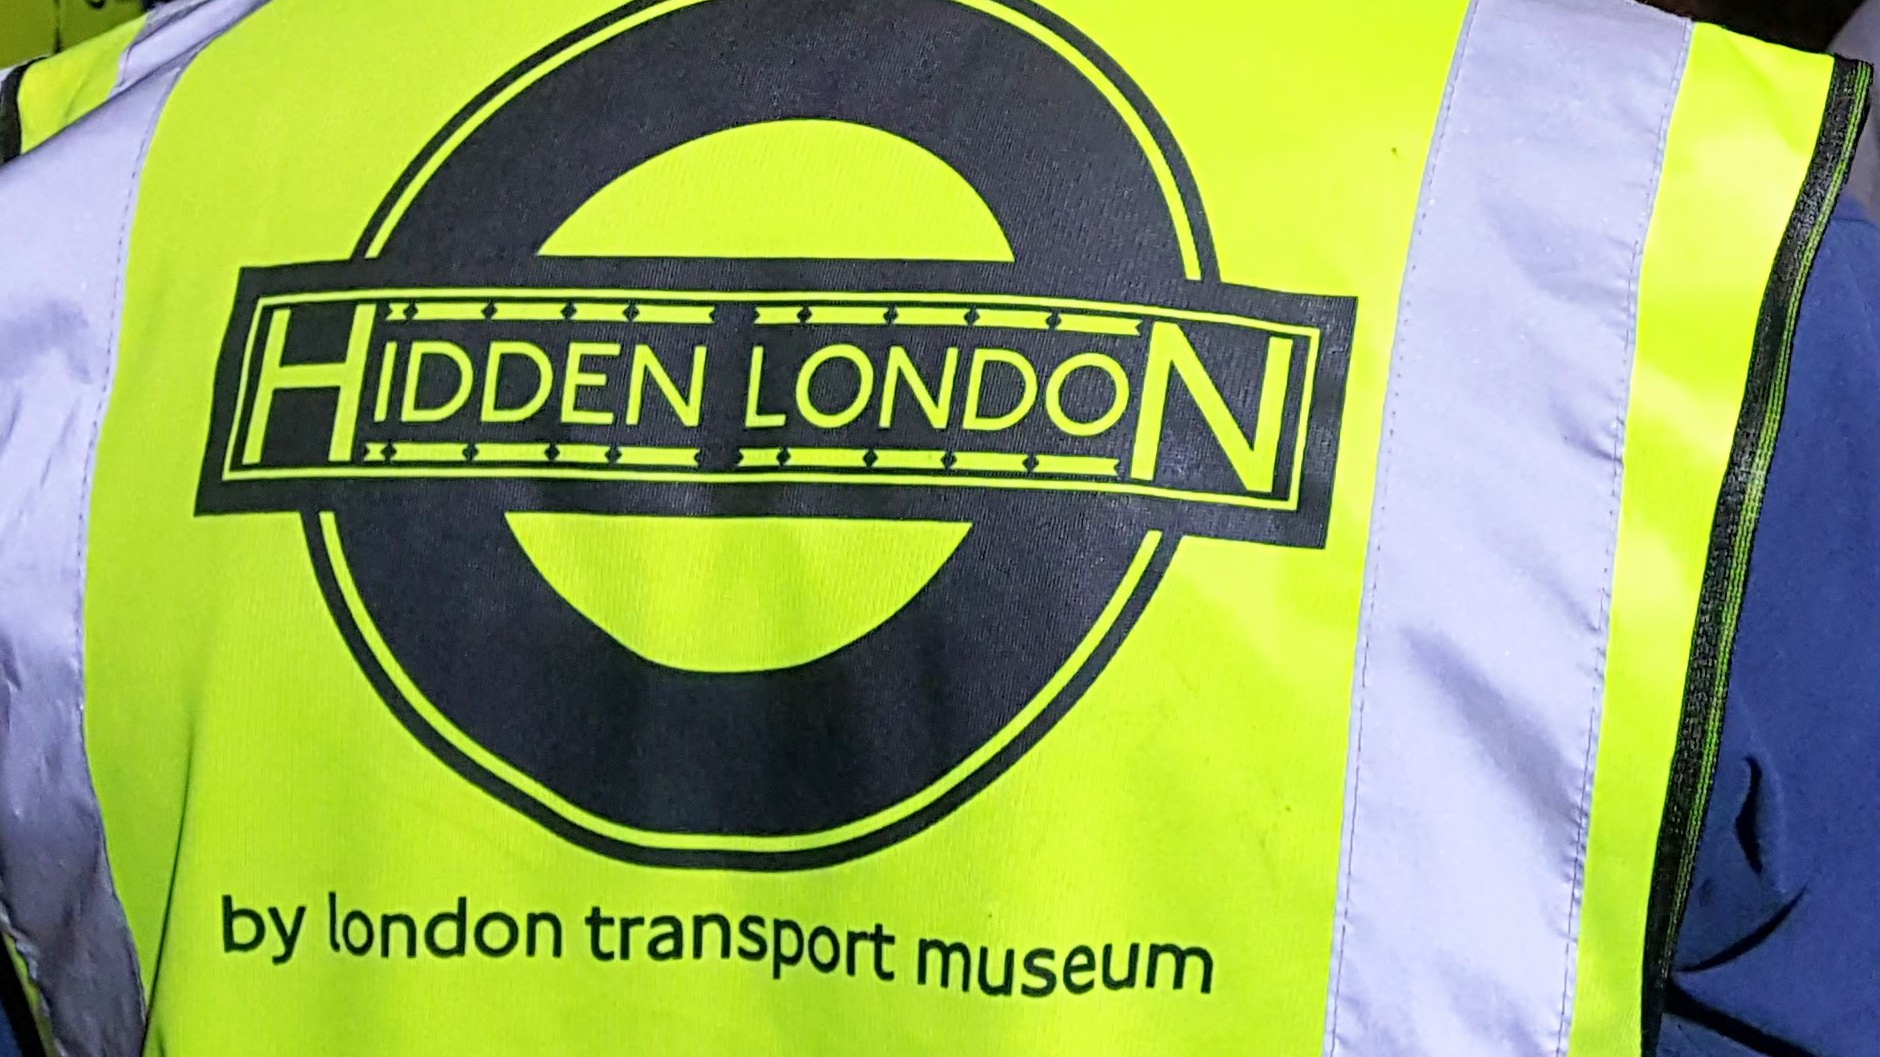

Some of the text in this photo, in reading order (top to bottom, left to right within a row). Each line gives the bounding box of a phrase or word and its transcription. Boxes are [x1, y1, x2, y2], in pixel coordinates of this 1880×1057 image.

[242, 304, 1294, 493] HIDDEN LONDON
[221, 891, 1215, 998] by london transport museum
